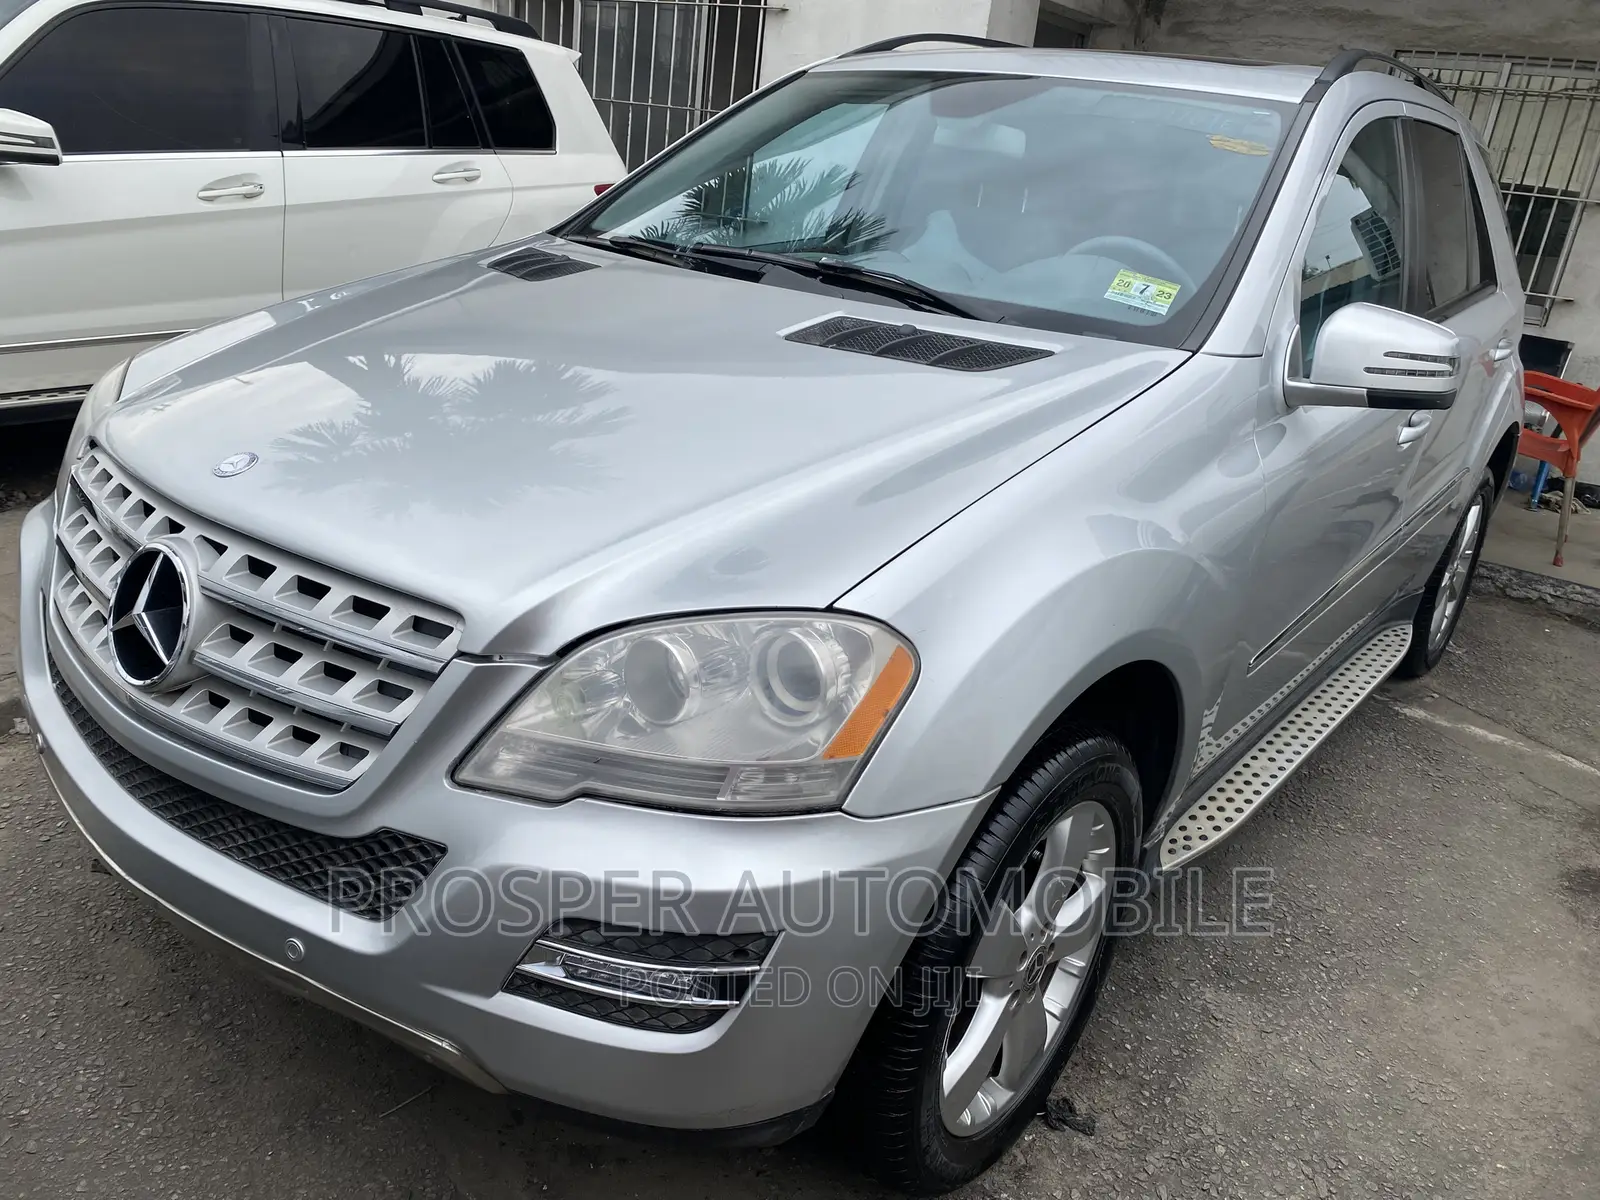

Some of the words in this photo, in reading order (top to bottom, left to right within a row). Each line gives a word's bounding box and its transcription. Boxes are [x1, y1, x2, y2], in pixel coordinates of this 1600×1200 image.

[1116, 279, 1131, 289] 20
[1139, 283, 1151, 295] 7
[1156, 290, 1172, 300] 23
